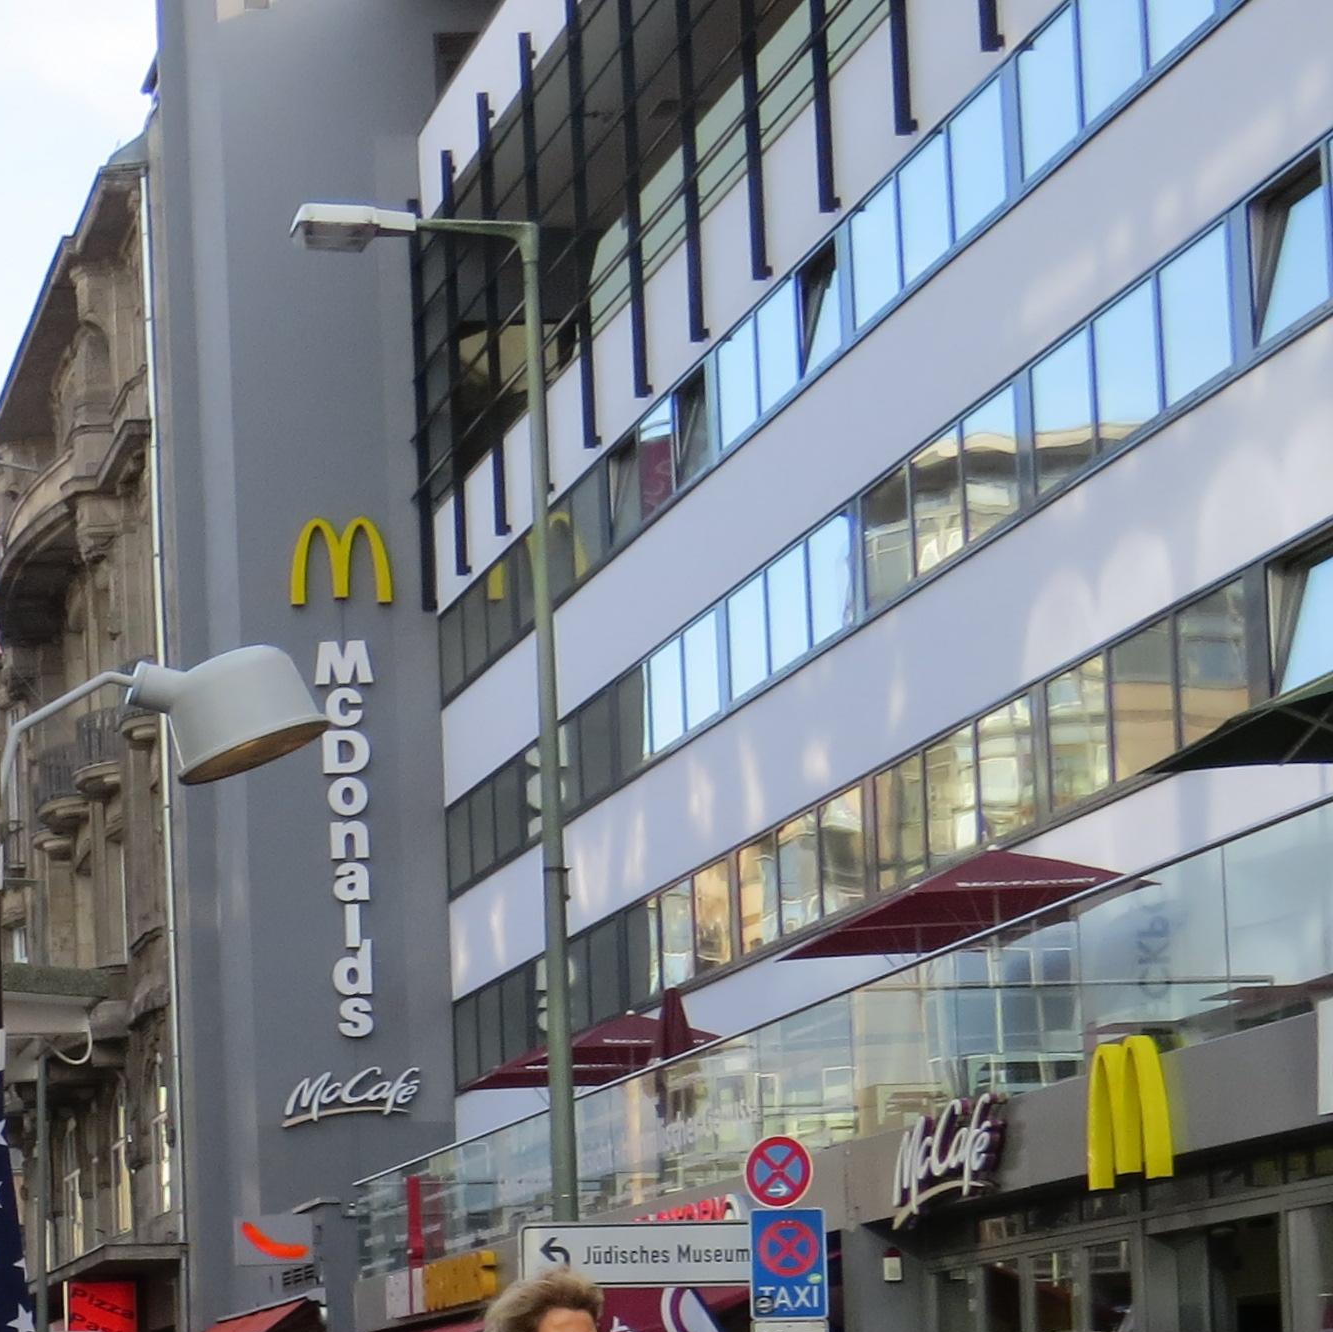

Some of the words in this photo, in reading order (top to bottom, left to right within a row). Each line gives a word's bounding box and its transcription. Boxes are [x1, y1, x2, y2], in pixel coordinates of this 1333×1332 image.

[315, 640, 374, 1038] McDonalds
[284, 1066, 421, 1118] McCafé
[893, 1093, 996, 1214] McCafé
[582, 1244, 671, 1265] Jüdisches
[677, 1245, 750, 1263] Museum
[72, 1287, 134, 1319] Pizza
[758, 1286, 820, 1309] TAXI
